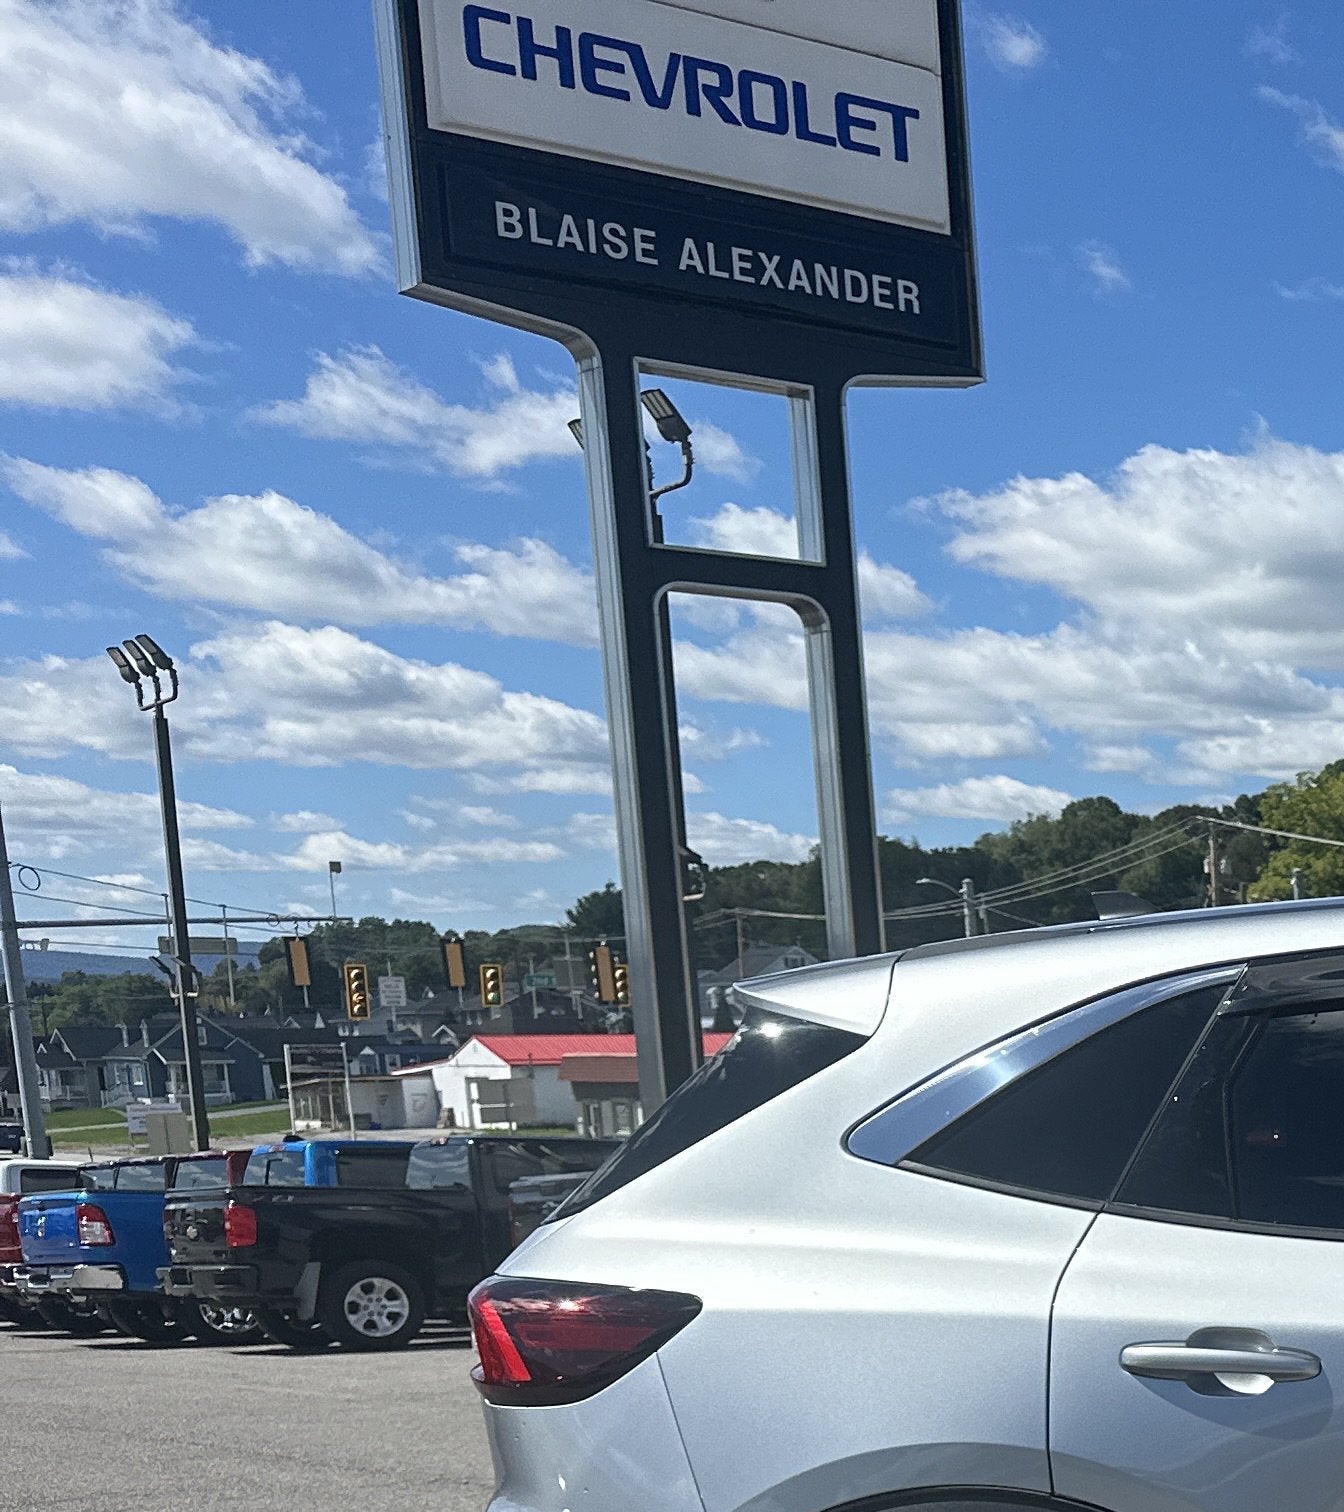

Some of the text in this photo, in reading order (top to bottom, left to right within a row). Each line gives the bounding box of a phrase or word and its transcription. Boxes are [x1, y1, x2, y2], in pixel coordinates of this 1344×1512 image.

[462, 3, 920, 163] CHEVROLET
[493, 200, 921, 314] BLAISE ALEXANDER
